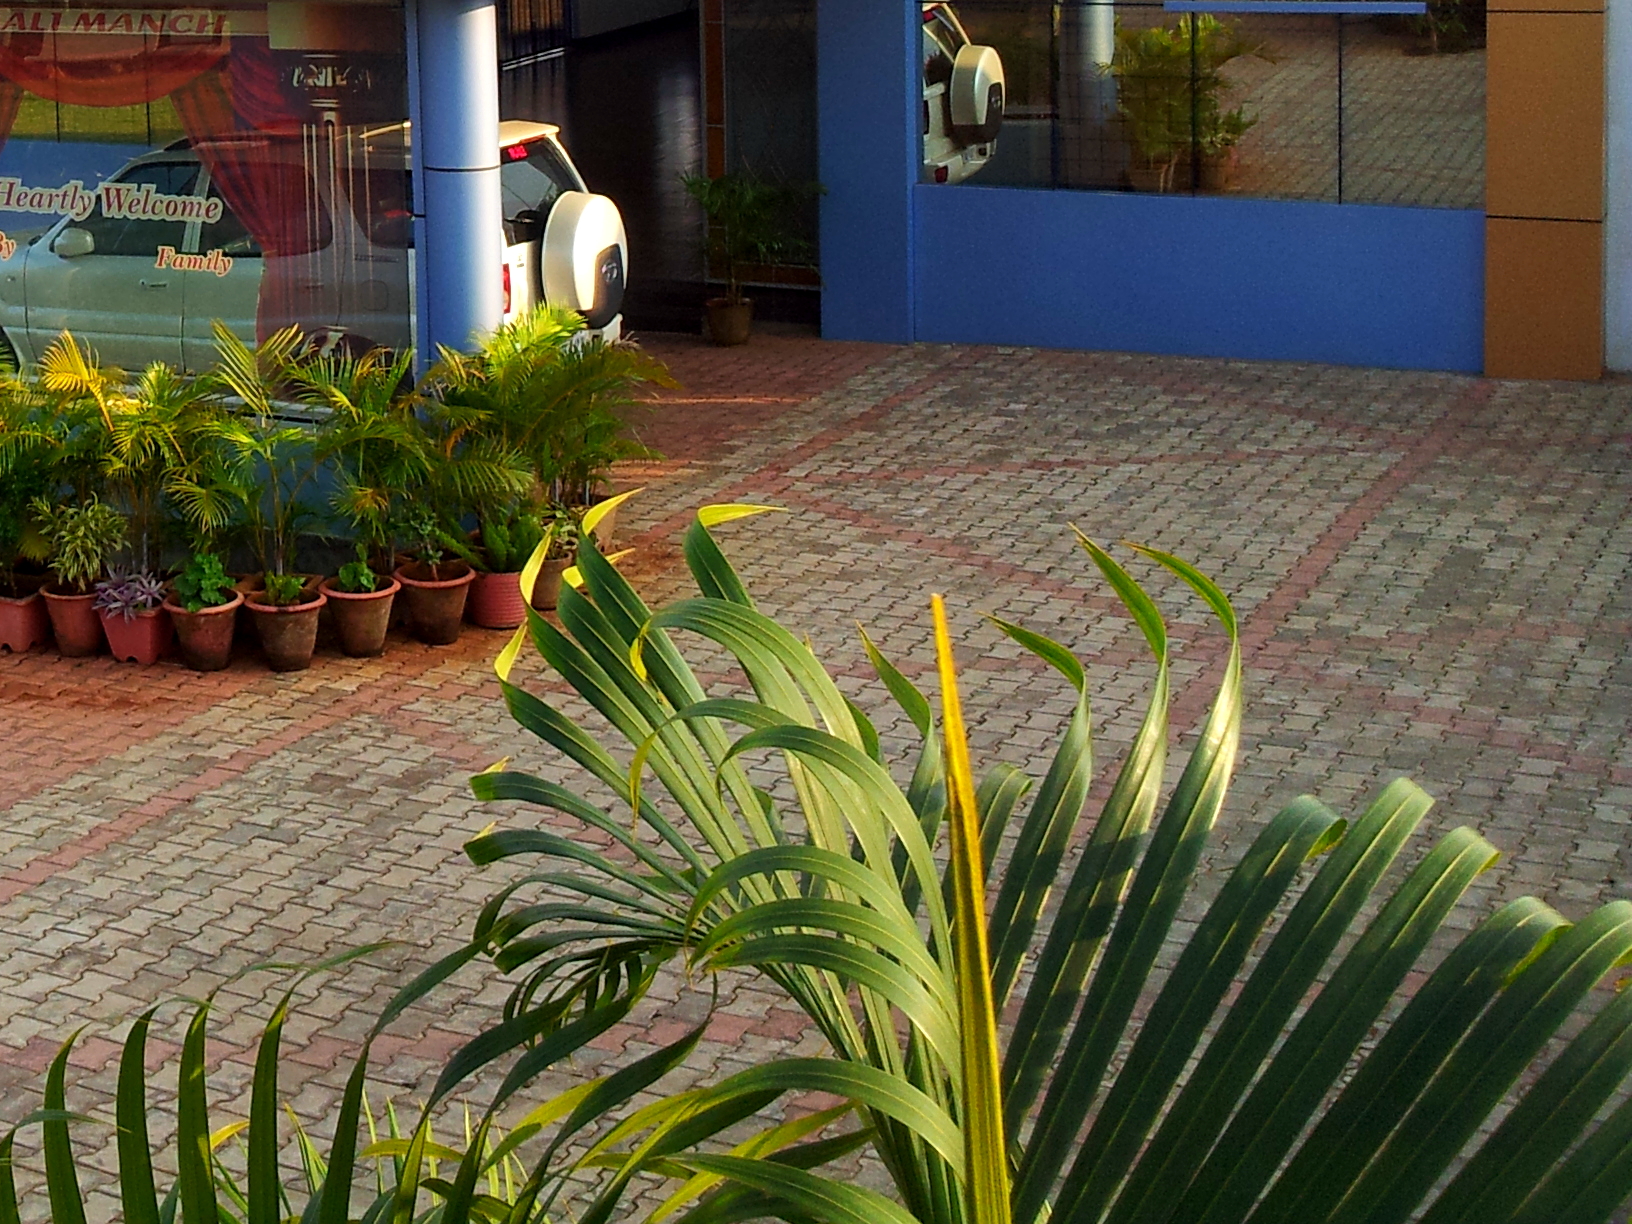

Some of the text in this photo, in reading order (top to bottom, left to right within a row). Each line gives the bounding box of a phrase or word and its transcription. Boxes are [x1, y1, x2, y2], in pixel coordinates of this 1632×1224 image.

[73, 11, 227, 35] MANCH
[101, 184, 220, 219] Welcome
[155, 246, 233, 276] Family
